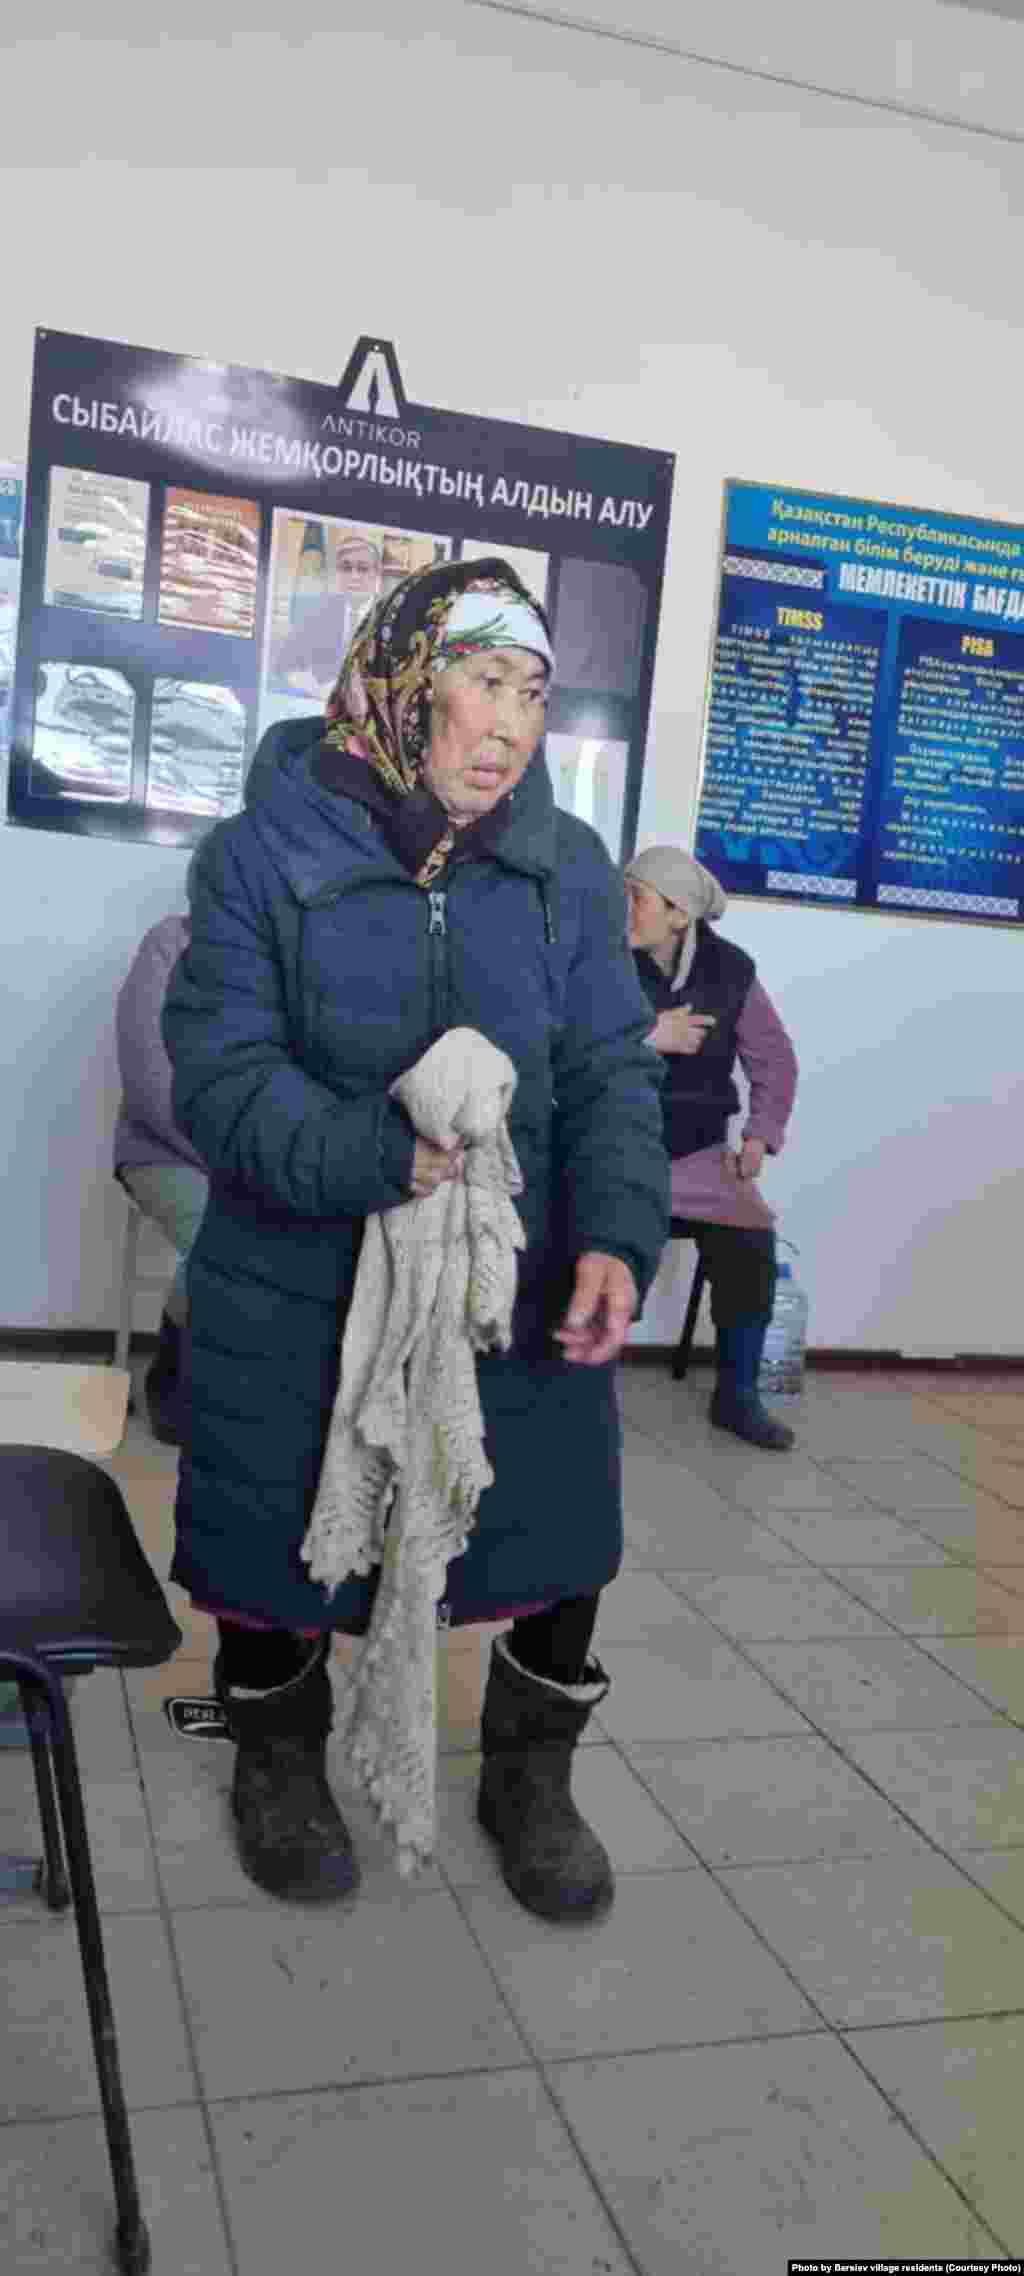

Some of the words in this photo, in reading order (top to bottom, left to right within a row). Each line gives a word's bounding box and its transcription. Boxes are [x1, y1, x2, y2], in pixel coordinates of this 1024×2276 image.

[320, 413, 422, 449] ANTIKOR
[52, 393, 223, 451] СЫБАЙЛАС
[231, 427, 485, 507] ЖЕМҚОРЛЫҚТЫҢ
[490, 476, 593, 520] АЛДЫН
[597, 495, 654, 530] АЛУ
[772, 496, 864, 531] Қазақстан
[839, 560, 968, 609] МЕМЛЕКЕТТІК
[777, 608, 824, 632] TIMSS
[960, 635, 994, 657] PISA
